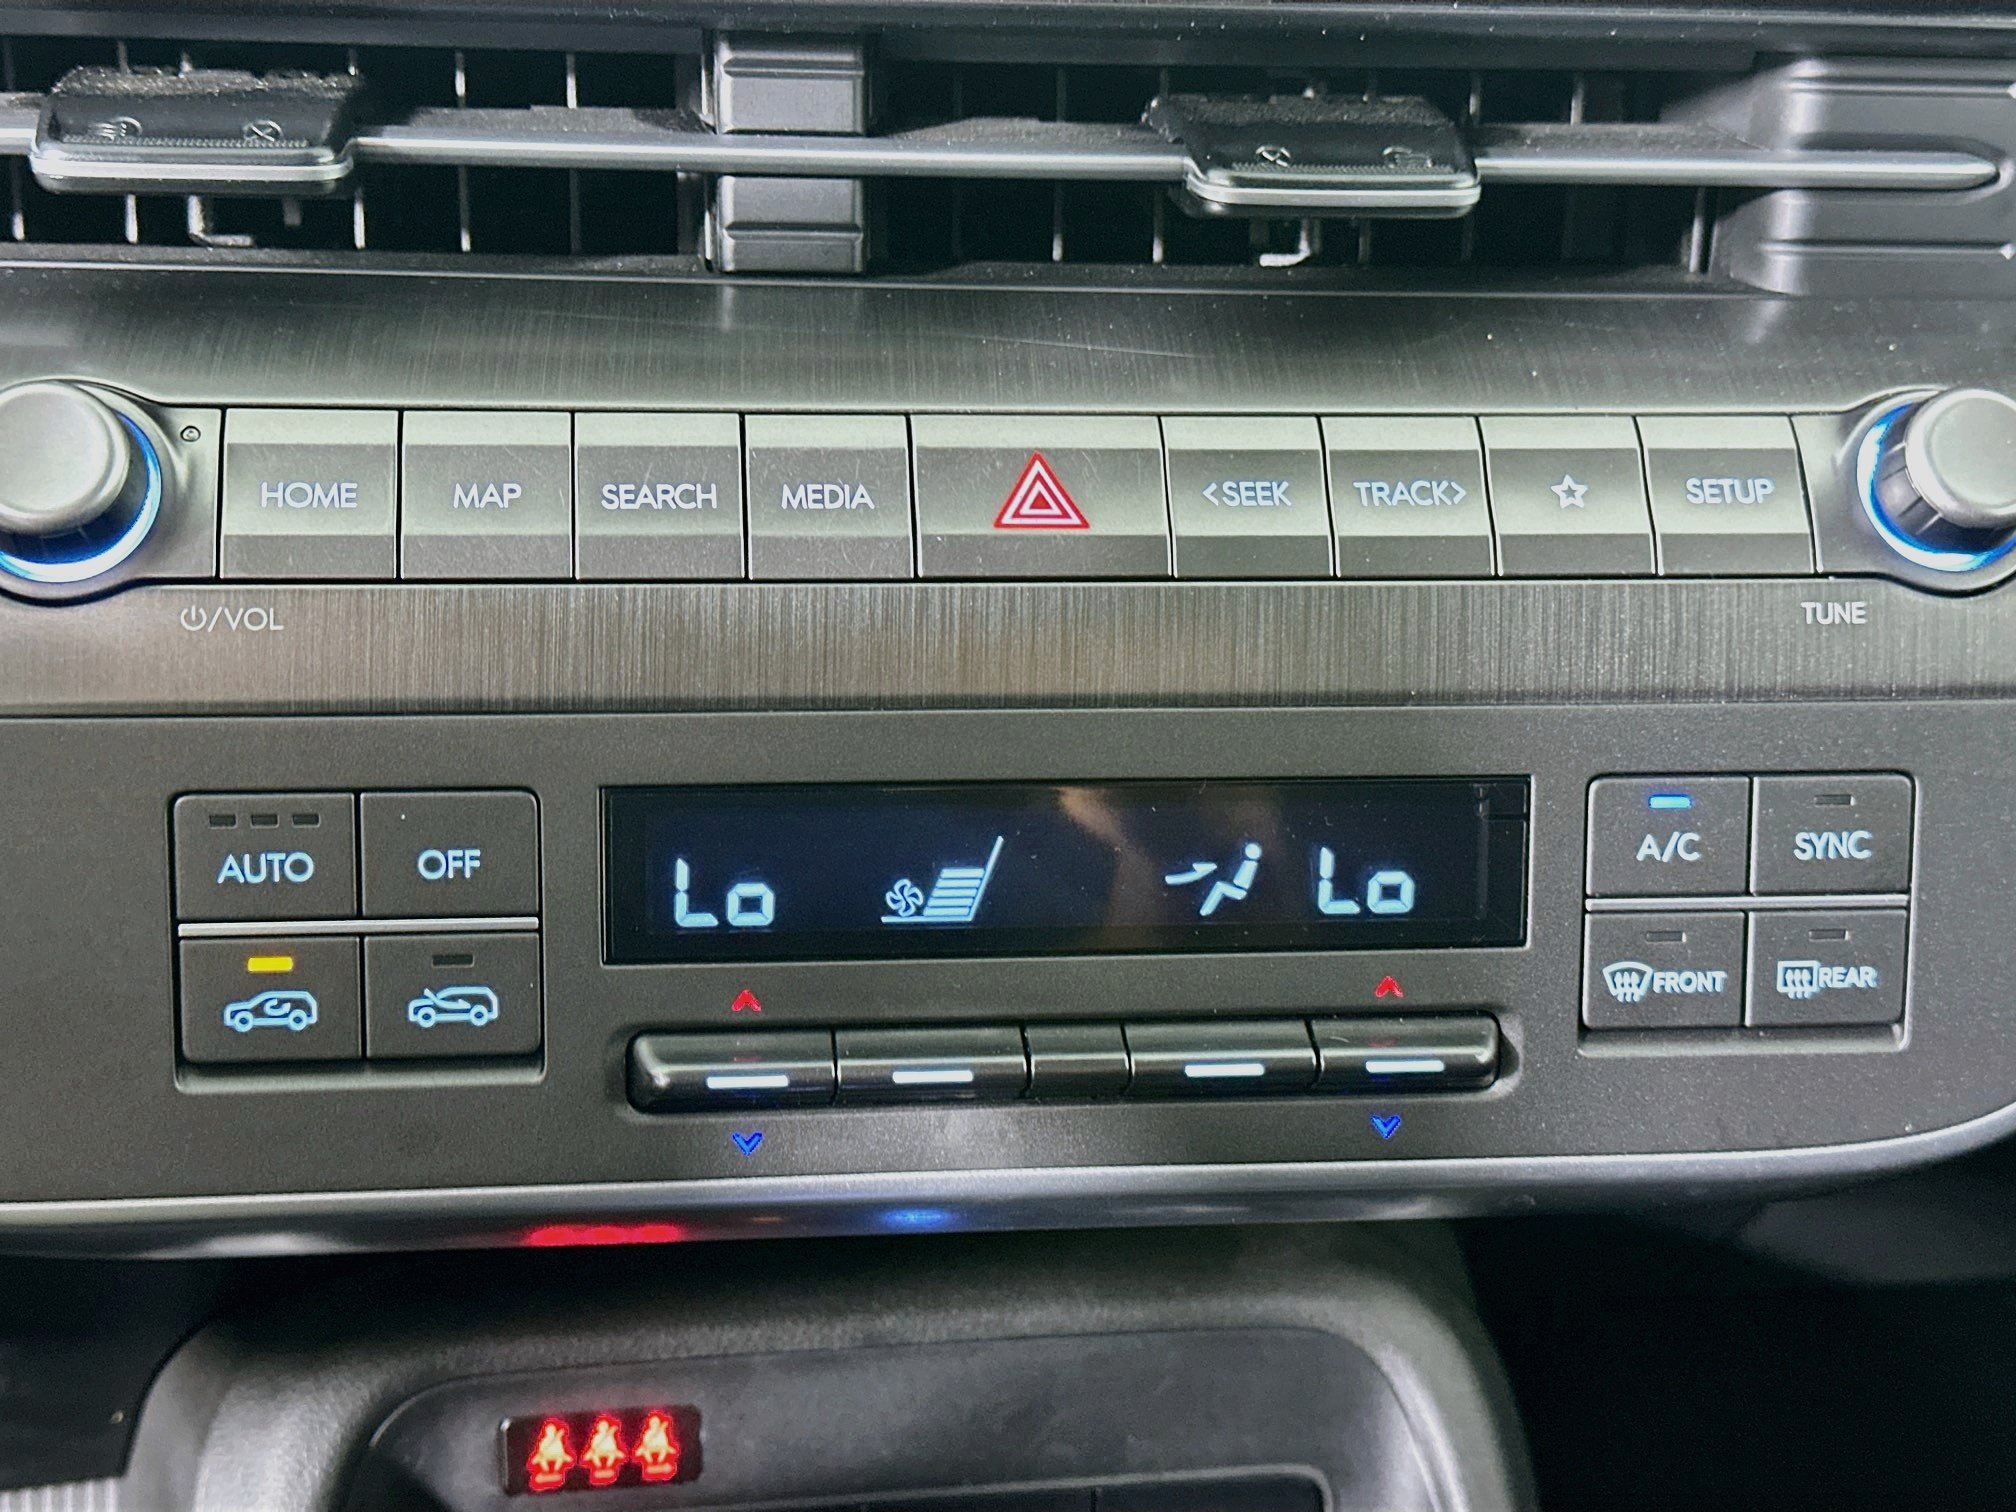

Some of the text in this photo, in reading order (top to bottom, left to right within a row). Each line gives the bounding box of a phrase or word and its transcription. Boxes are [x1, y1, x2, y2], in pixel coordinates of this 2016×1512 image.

[260, 481, 358, 509] HOME
[453, 483, 523, 509] MAP
[601, 483, 718, 510] SEARCH
[781, 483, 875, 510] MEDIA
[1685, 477, 1774, 505] SETUP
[1801, 601, 1867, 626] TUNE
[1636, 832, 1701, 863] A/C
[1792, 830, 1874, 861] SYNC
[217, 852, 315, 884] AUTO
[417, 848, 482, 880] OFF
[1652, 970, 1727, 994] FRONT
[1817, 966, 1878, 989] REAR
